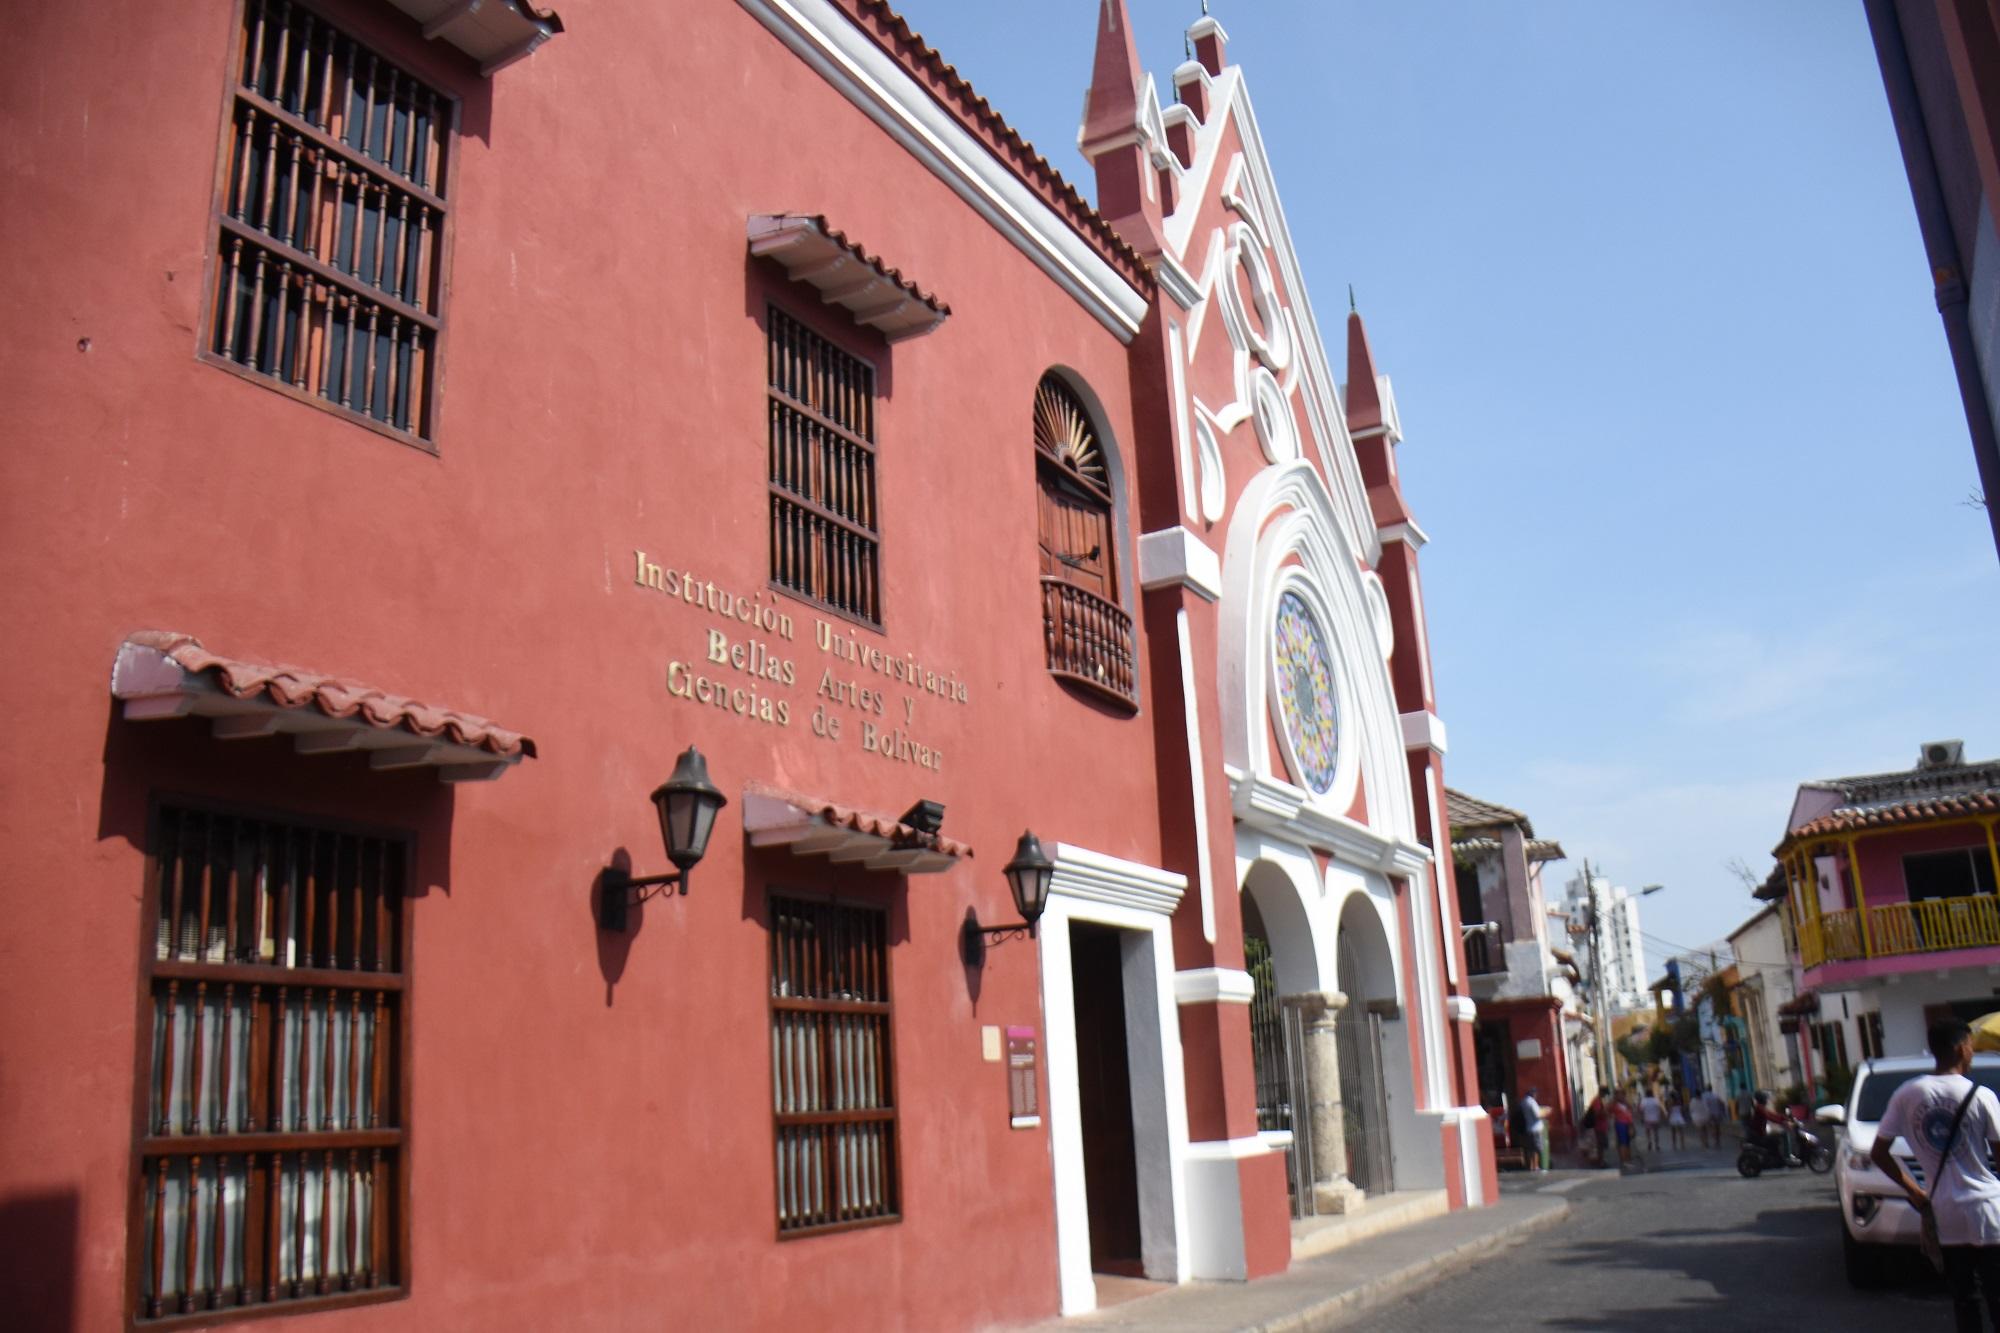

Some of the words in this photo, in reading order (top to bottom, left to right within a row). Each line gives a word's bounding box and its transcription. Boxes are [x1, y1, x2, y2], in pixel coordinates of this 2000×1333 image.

[667, 660, 790, 726] Ciencias
[812, 704, 841, 740] de
[707, 629, 795, 686] Bellas
[817, 668, 884, 715] Artes
[904, 695, 914, 726] y
[815, 619, 968, 704] Universitaria
